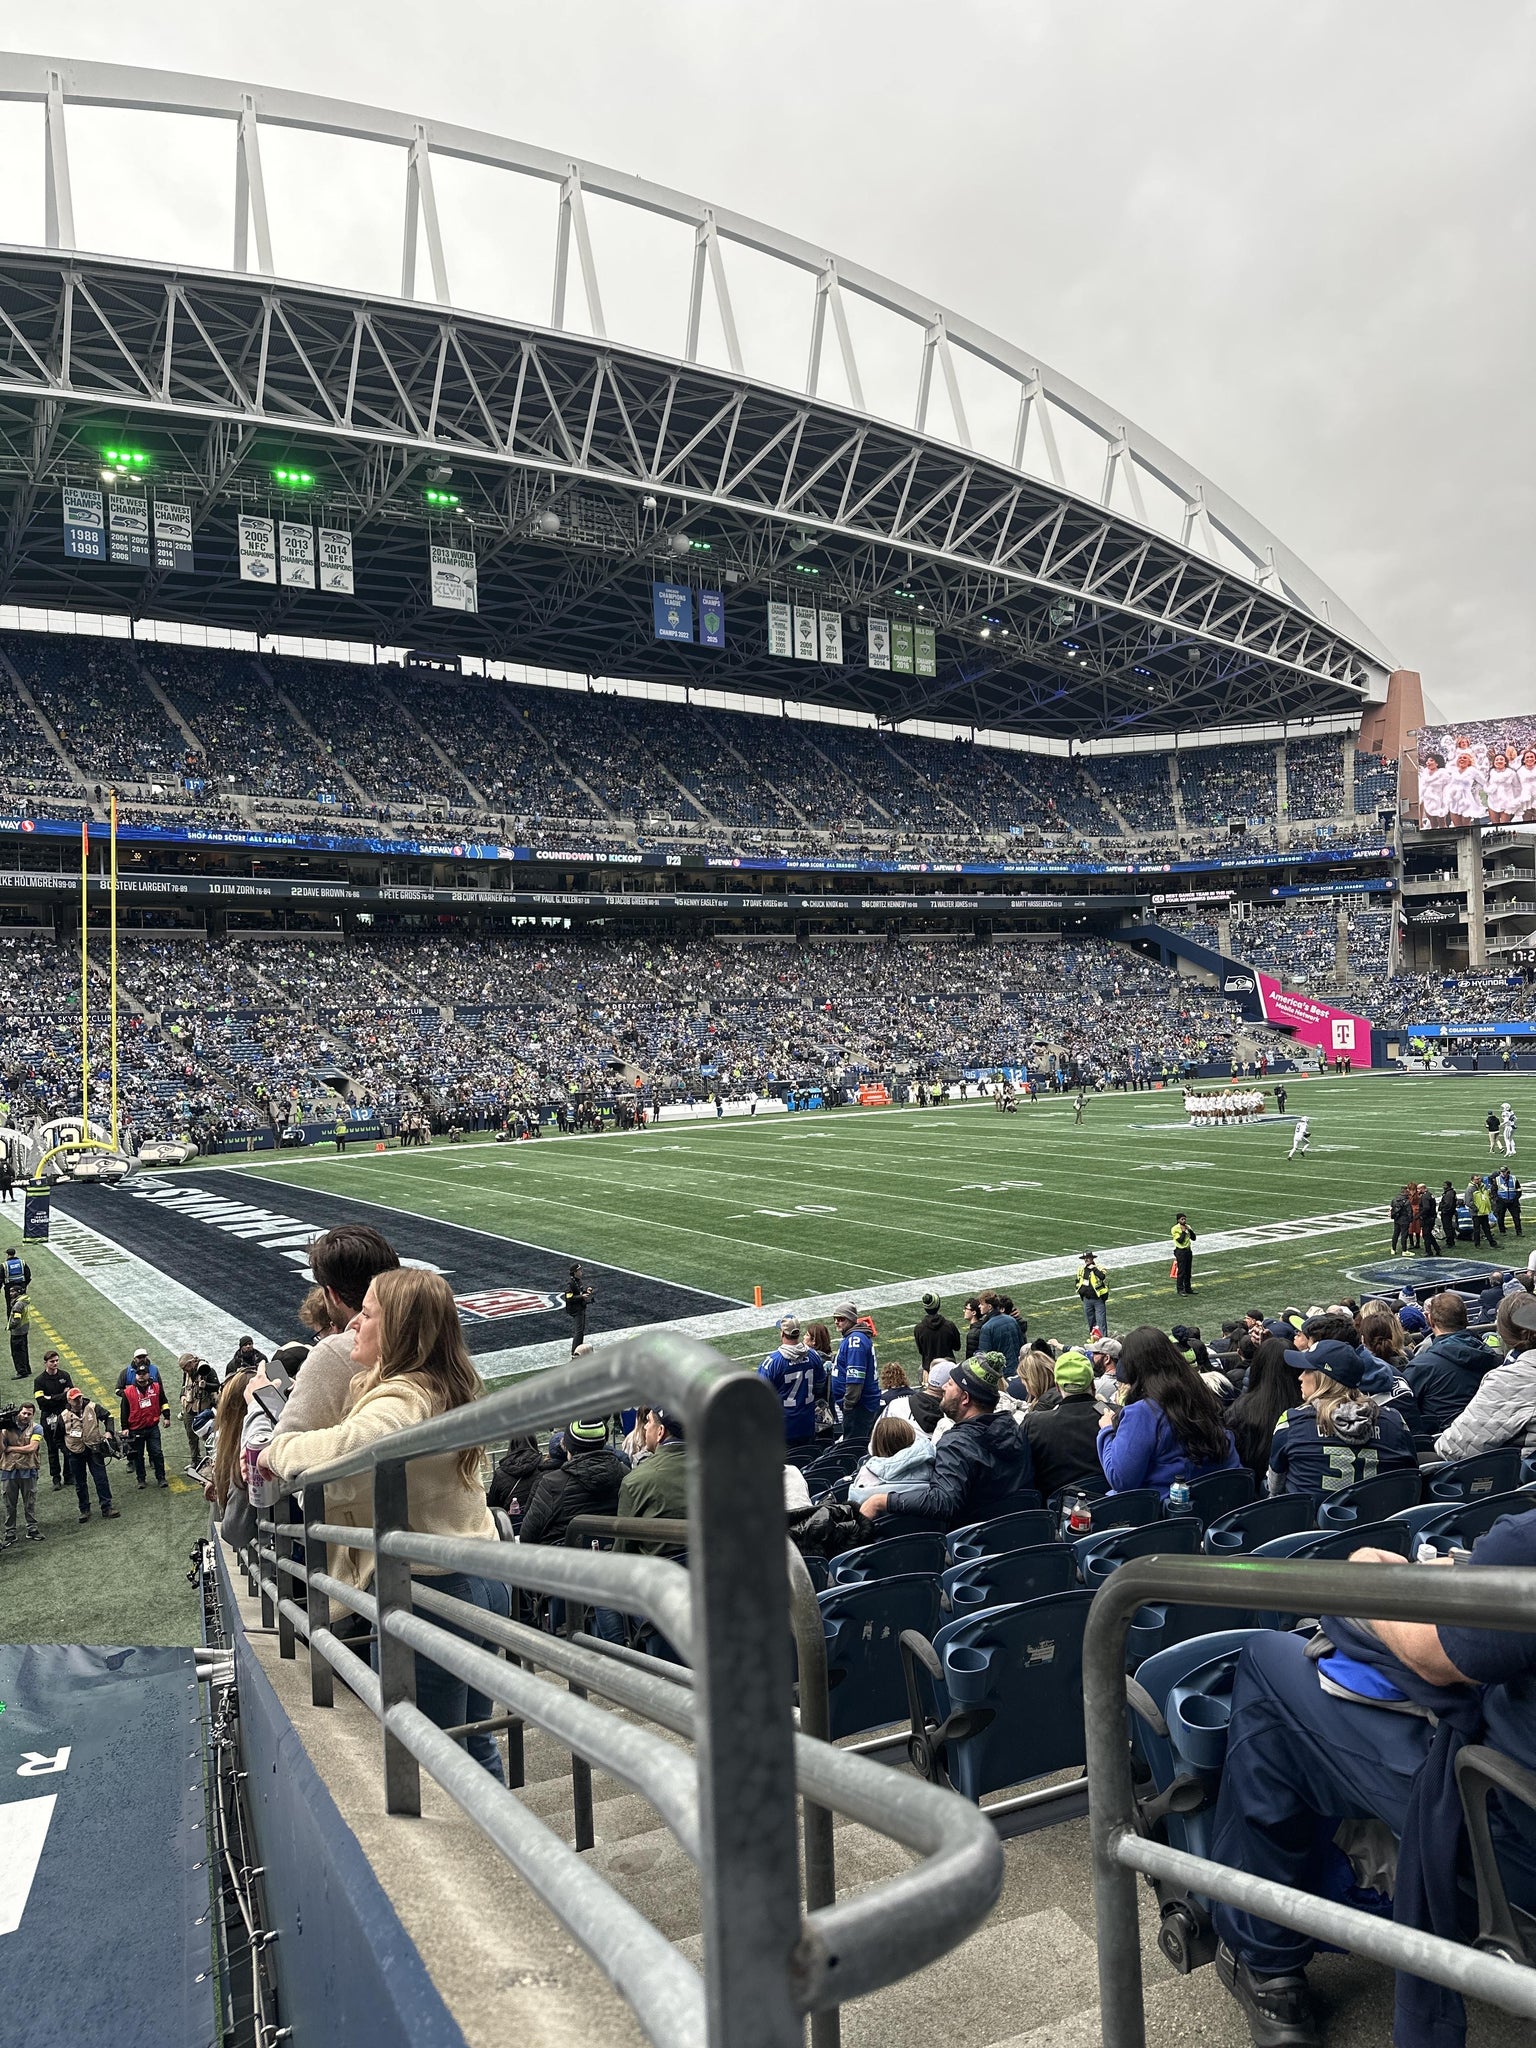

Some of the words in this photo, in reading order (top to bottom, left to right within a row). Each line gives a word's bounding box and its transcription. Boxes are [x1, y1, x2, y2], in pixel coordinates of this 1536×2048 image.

[80, 491, 101, 500] WEST
[65, 497, 101, 509] CHAMPS
[126, 498, 146, 508] WEST
[111, 504, 146, 517] CHAMPS
[171, 505, 190, 514] WEST
[155, 511, 190, 523] CHAMPS
[70, 529, 98, 542] 1988
[245, 531, 268, 542] 2005
[71, 542, 99, 555] 1999
[249, 542, 266, 551] NFC
[285, 538, 308, 549] 2013
[241, 549, 274, 559] CHAMPIONS
[289, 548, 305, 558] NFC
[325, 544, 347, 555] 2014
[432, 548, 449, 557] 2013
[451, 551, 473, 561] WORLD
[281, 556, 313, 566] CHAMPIONS
[328, 554, 344, 563] NFC
[433, 556, 474, 568] CHAMPIONS
[321, 561, 352, 572] CHAMPIONS
[660, 628, 677, 637] CHAMPS
[420, 845, 452, 854] SAFEWAY
[536, 851, 593, 861] COUNTDOWN
[609, 854, 642, 863] KICKOFF
[15, 877, 58, 888] HOLMGREN
[115, 881, 137, 891] STEVE
[139, 882, 171, 892] LARGENT
[209, 884, 220, 893] 10
[221, 885, 235, 894] JIM
[236, 886, 255, 894] ZORN
[291, 887, 302, 896] 22
[303, 888, 320, 897] DAVE
[321, 889, 345, 897] BROWN
[452, 892, 462, 900] 28
[463, 893, 477, 901] CURT
[479, 893, 502, 902] WARNER
[1269, 991, 1310, 1011] America's
[1310, 1005, 1330, 1018] Best
[1275, 1002, 1294, 1013] Mobile
[1295, 1009, 1320, 1022] Network
[1337, 1025, 1349, 1043] T
[753, 1204, 838, 1218] 10
[848, 1336, 861, 1348] 12
[784, 1368, 815, 1407] 71
[1321, 1446, 1378, 1491] 31
[16, 1746, 72, 1776] R
